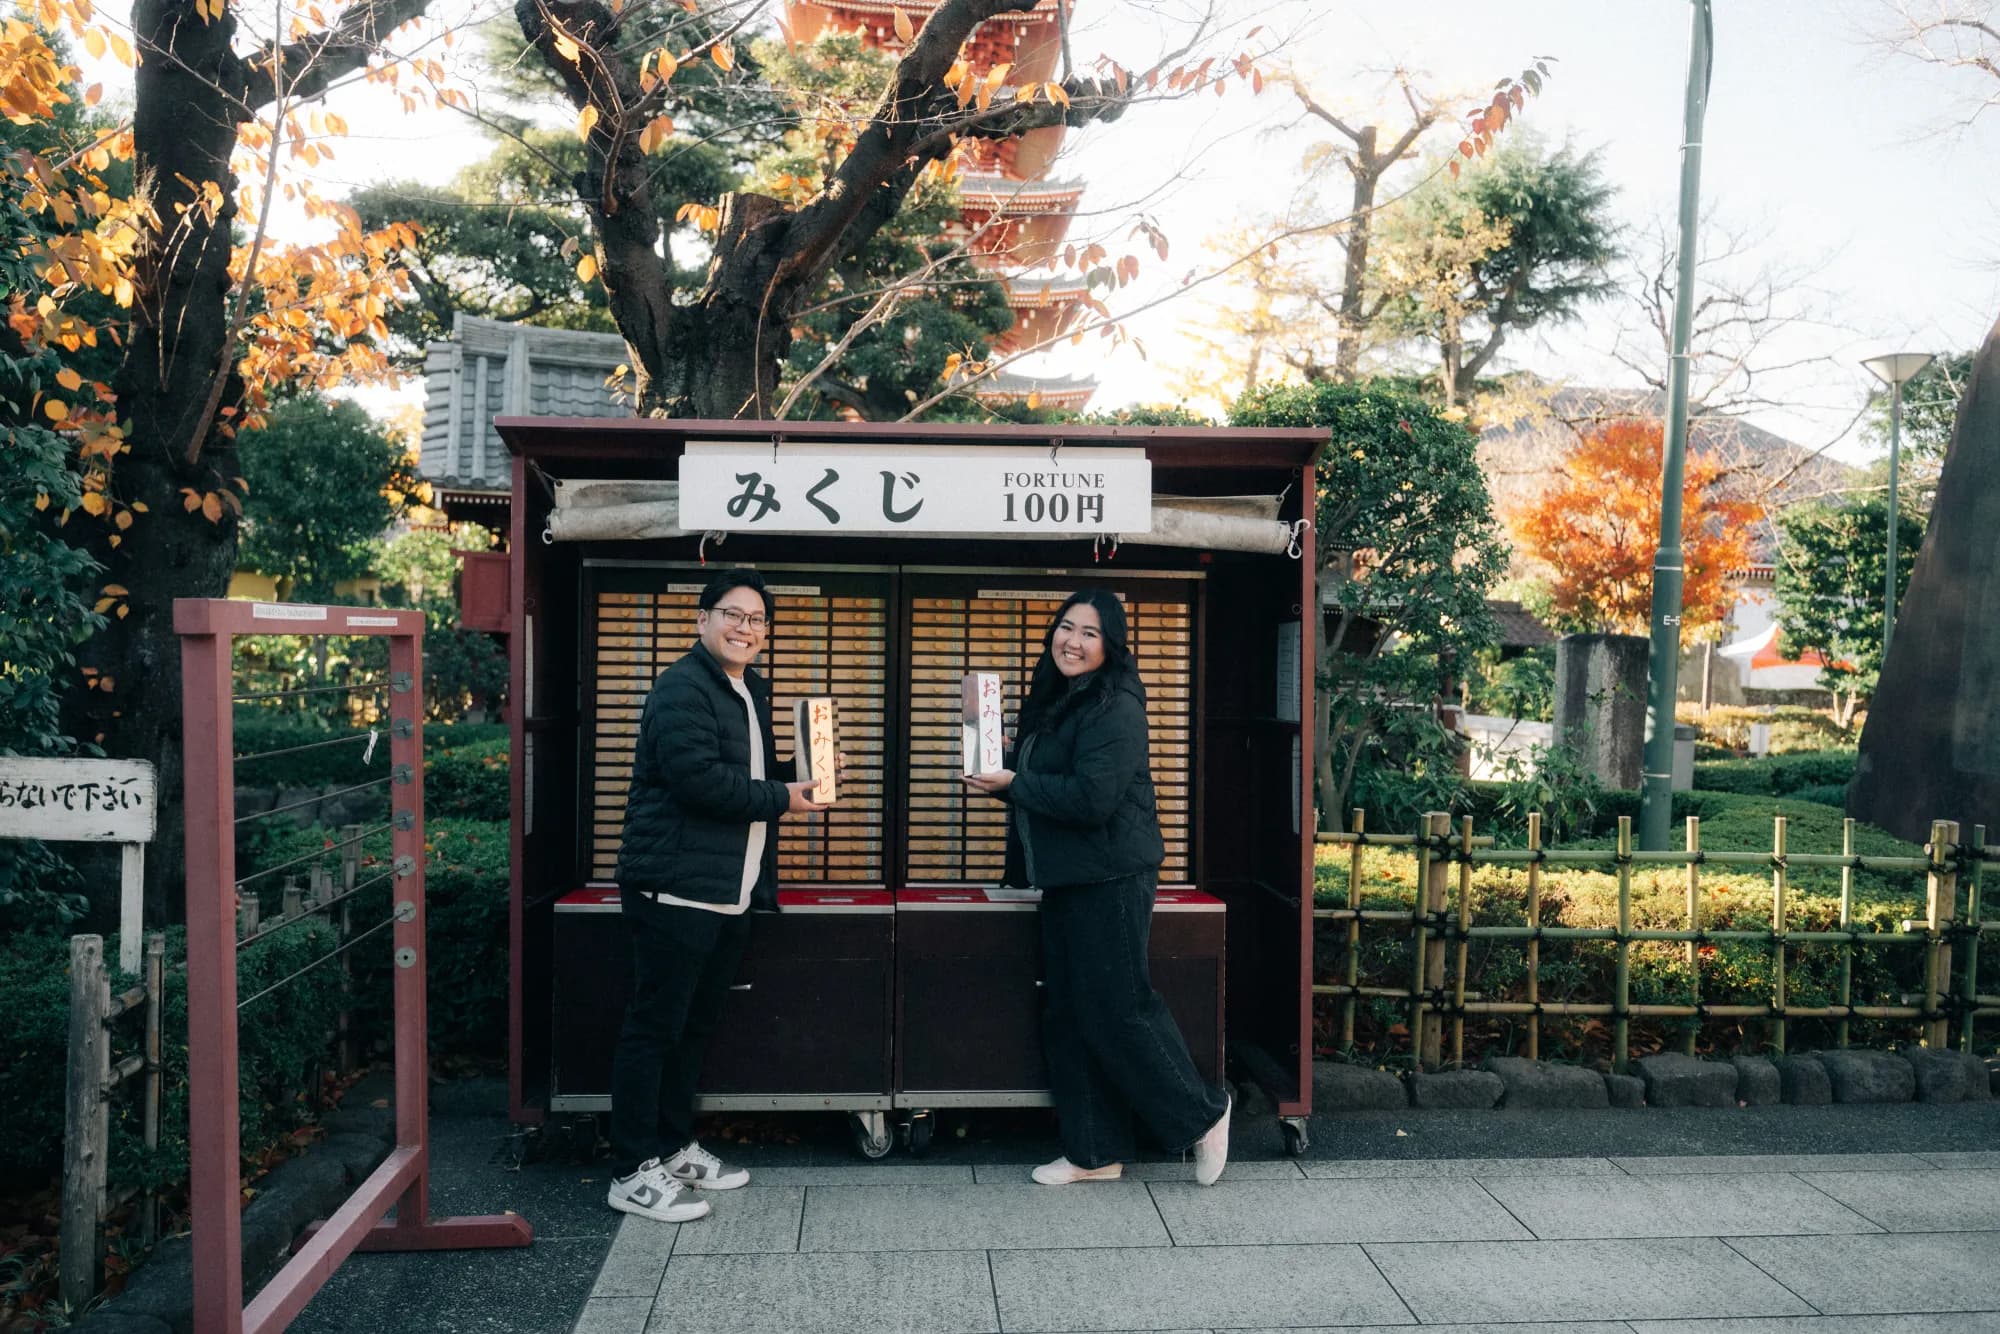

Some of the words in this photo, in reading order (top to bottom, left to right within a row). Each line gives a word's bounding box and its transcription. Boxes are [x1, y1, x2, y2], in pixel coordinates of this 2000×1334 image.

[726, 468, 925, 525] みくじ
[1002, 492, 1105, 524] 100円
[1003, 472, 1105, 489] FORTUNE
[813, 704, 831, 795] おみくじ
[983, 679, 1000, 767] おみくじ
